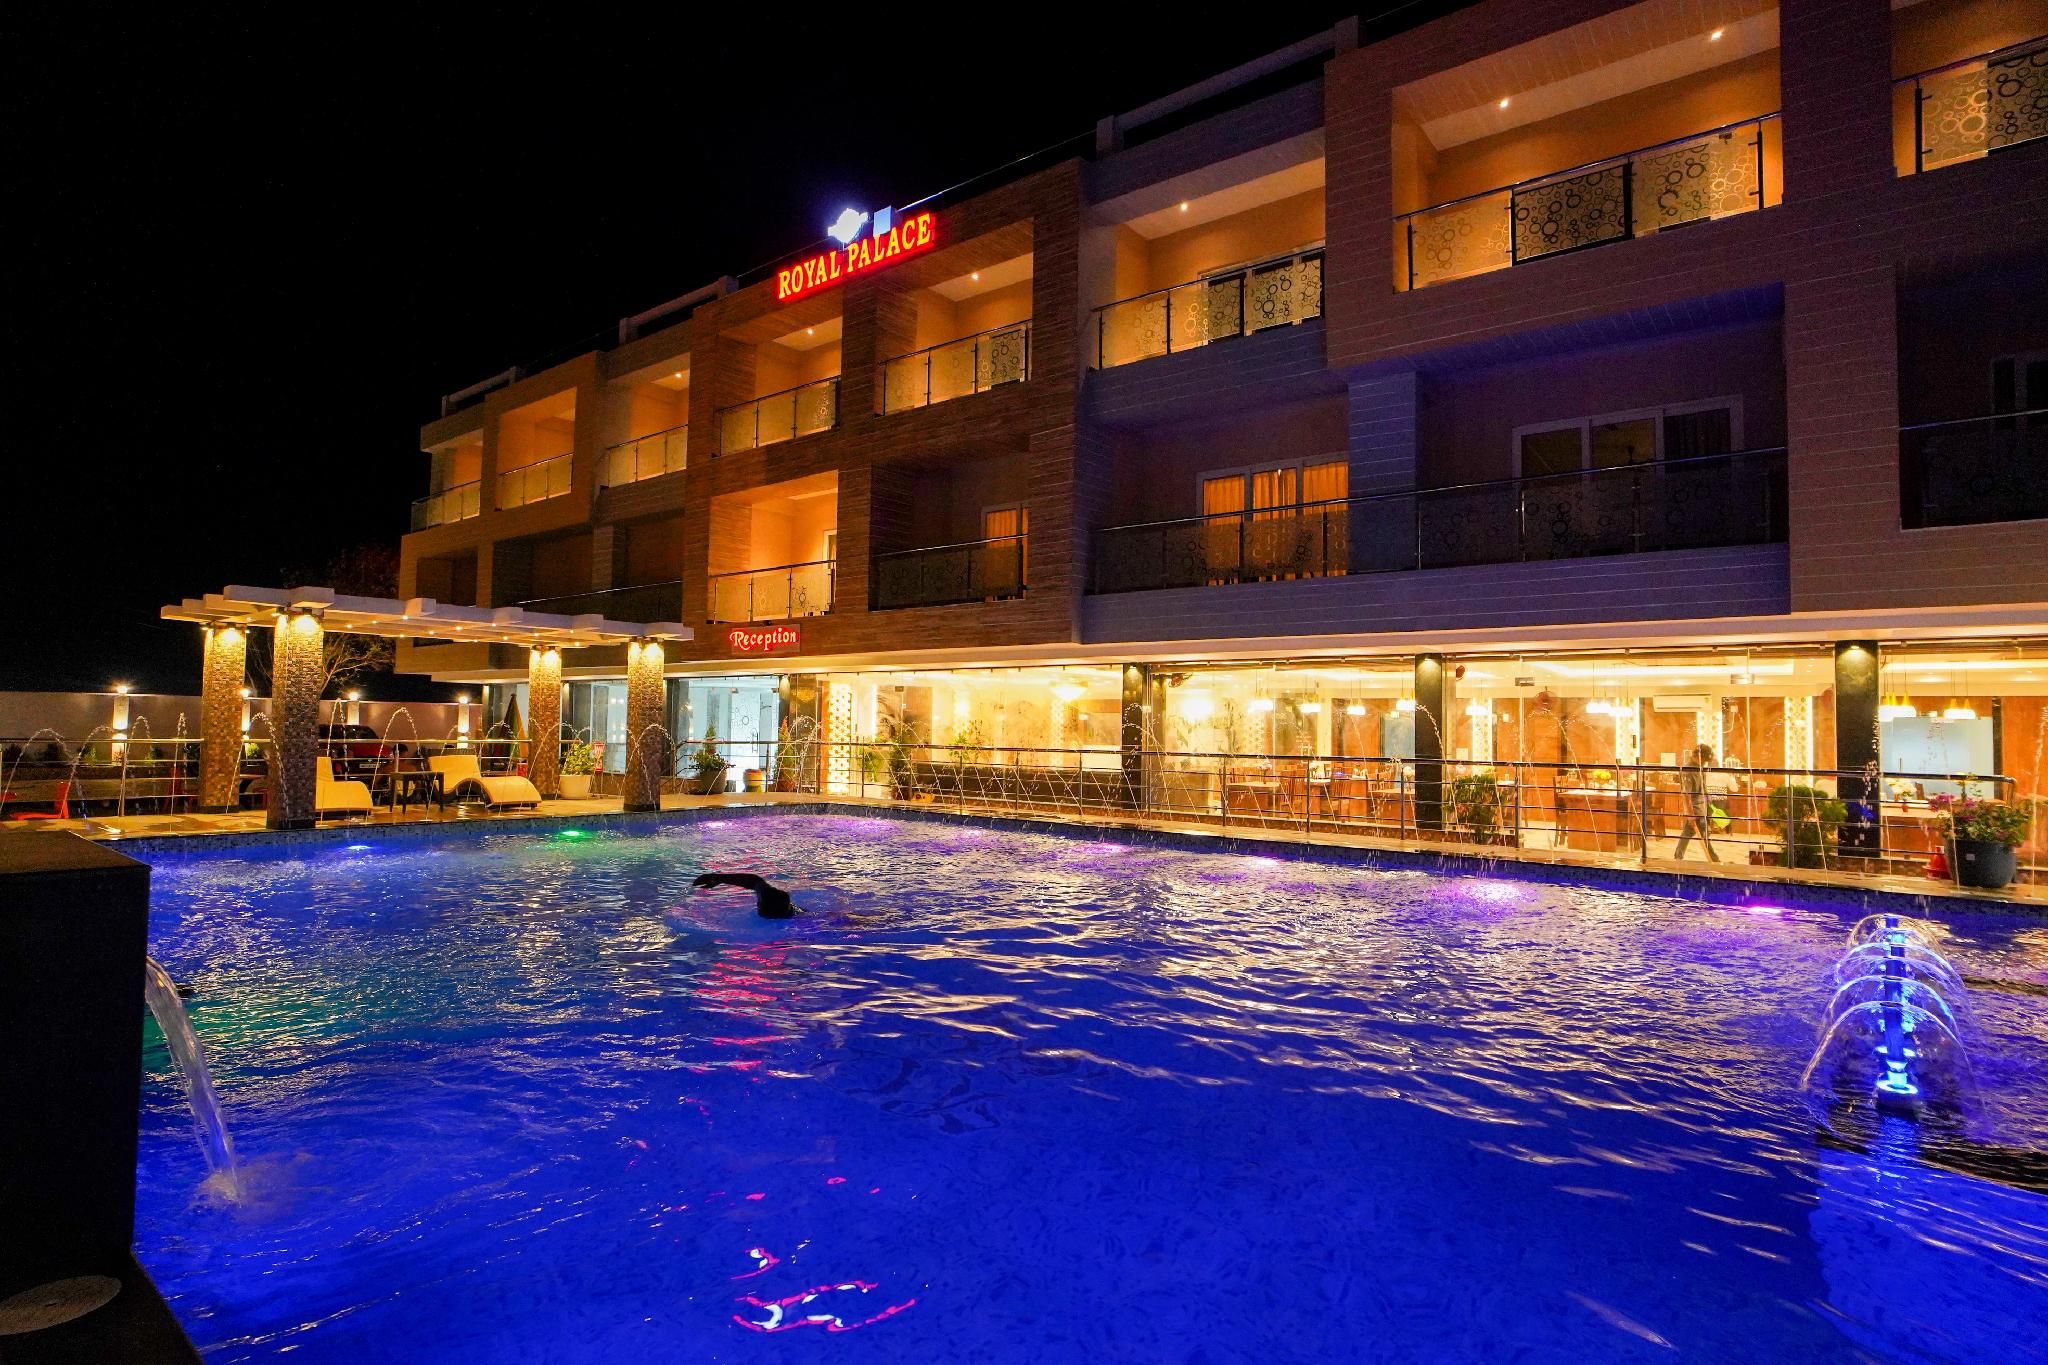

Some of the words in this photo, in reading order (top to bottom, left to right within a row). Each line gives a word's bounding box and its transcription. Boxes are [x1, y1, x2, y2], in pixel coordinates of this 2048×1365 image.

[778, 250, 841, 300] ROYAL
[847, 213, 932, 273] PALACE
[729, 627, 797, 651] Reception
